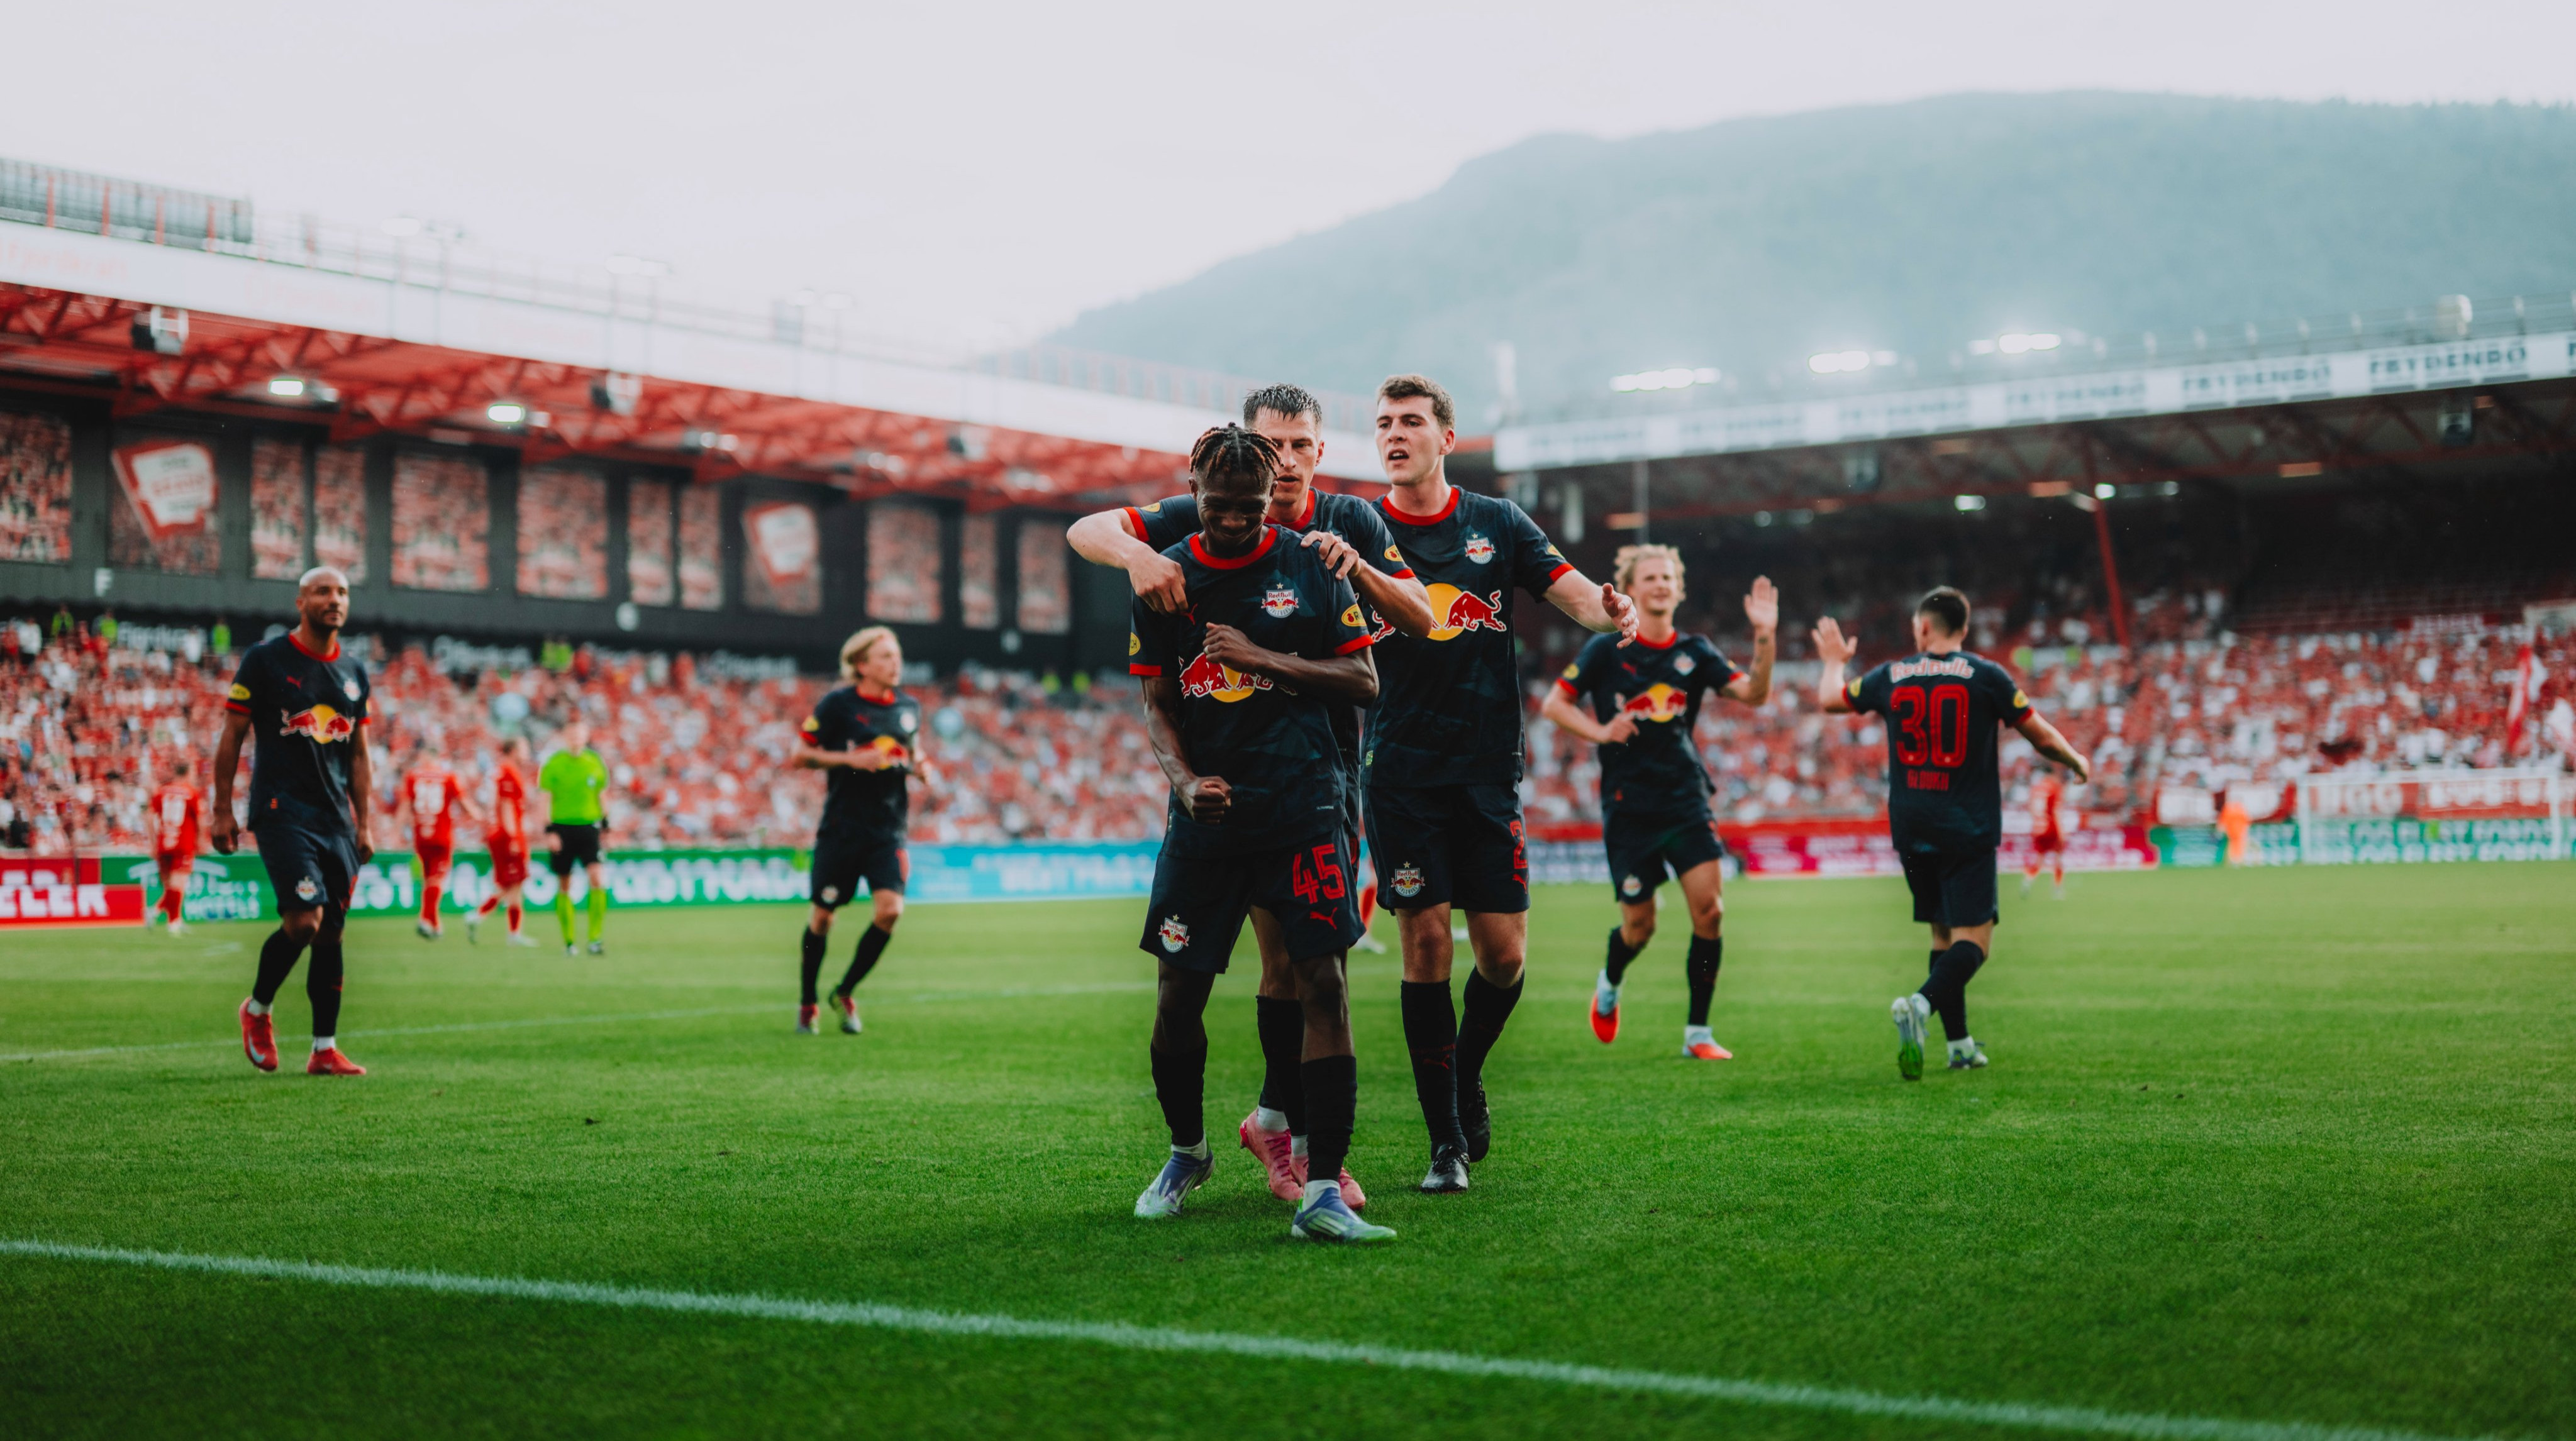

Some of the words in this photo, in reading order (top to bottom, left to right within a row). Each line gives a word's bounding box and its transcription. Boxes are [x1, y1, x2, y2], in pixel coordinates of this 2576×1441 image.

[1890, 657, 1928, 683] Red
[1928, 656, 1975, 679] Bulls
[1890, 684, 1970, 768] 30
[1292, 843, 1346, 905] 45
